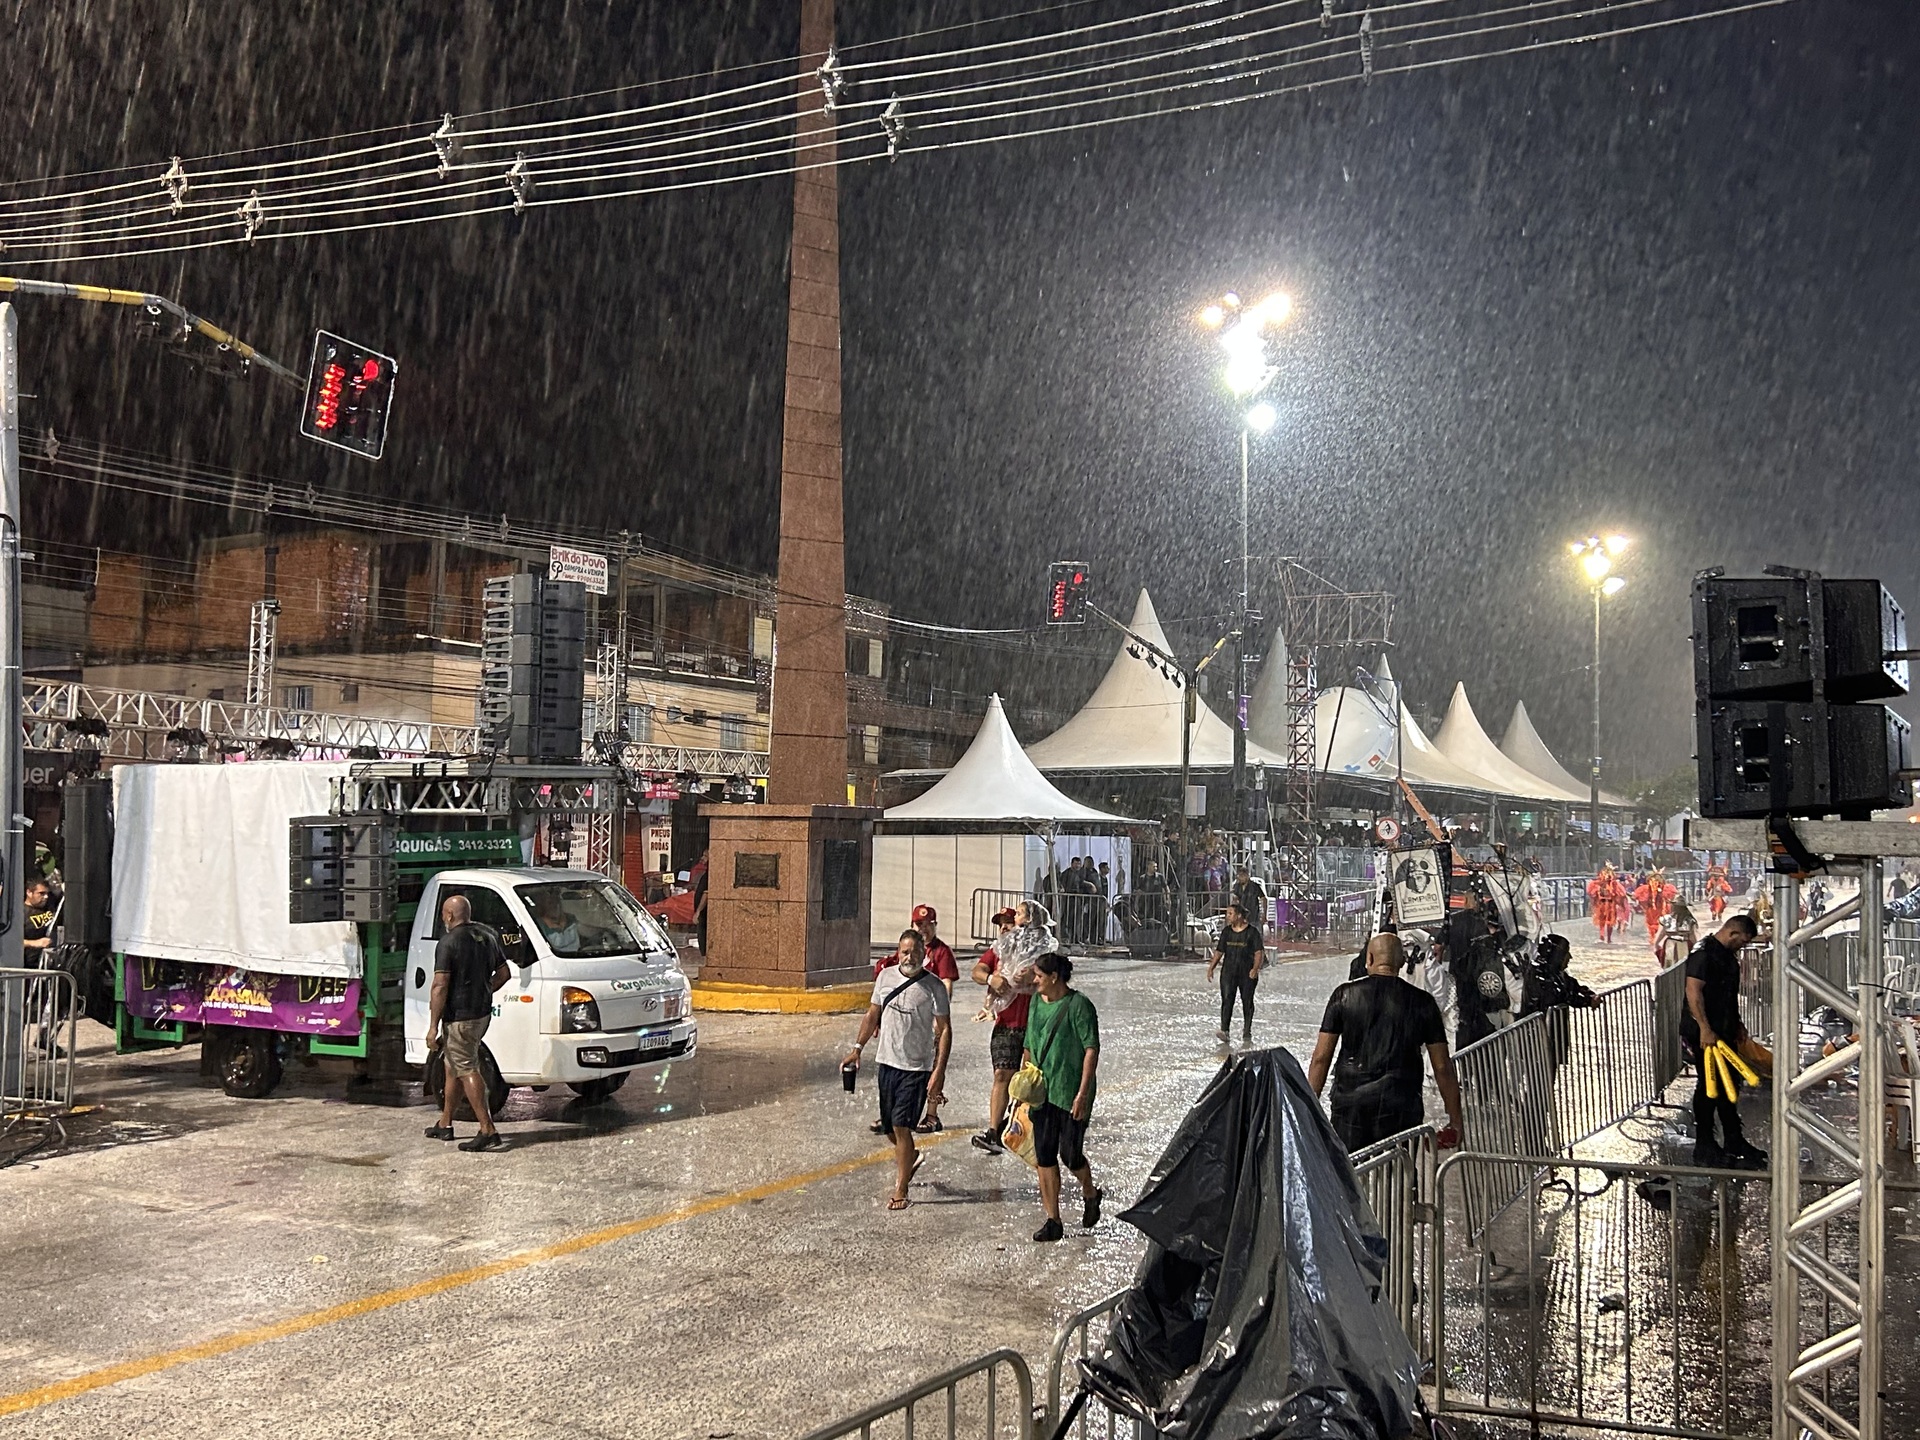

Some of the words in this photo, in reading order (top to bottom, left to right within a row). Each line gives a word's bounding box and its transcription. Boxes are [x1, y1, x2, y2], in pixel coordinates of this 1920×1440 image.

[570, 552, 581, 565] do
[23, 766, 55, 785] uer
[650, 828, 671, 838] PNEUS
[395, 836, 452, 853] IQUIGÁS
[650, 841, 669, 851] RODAS
